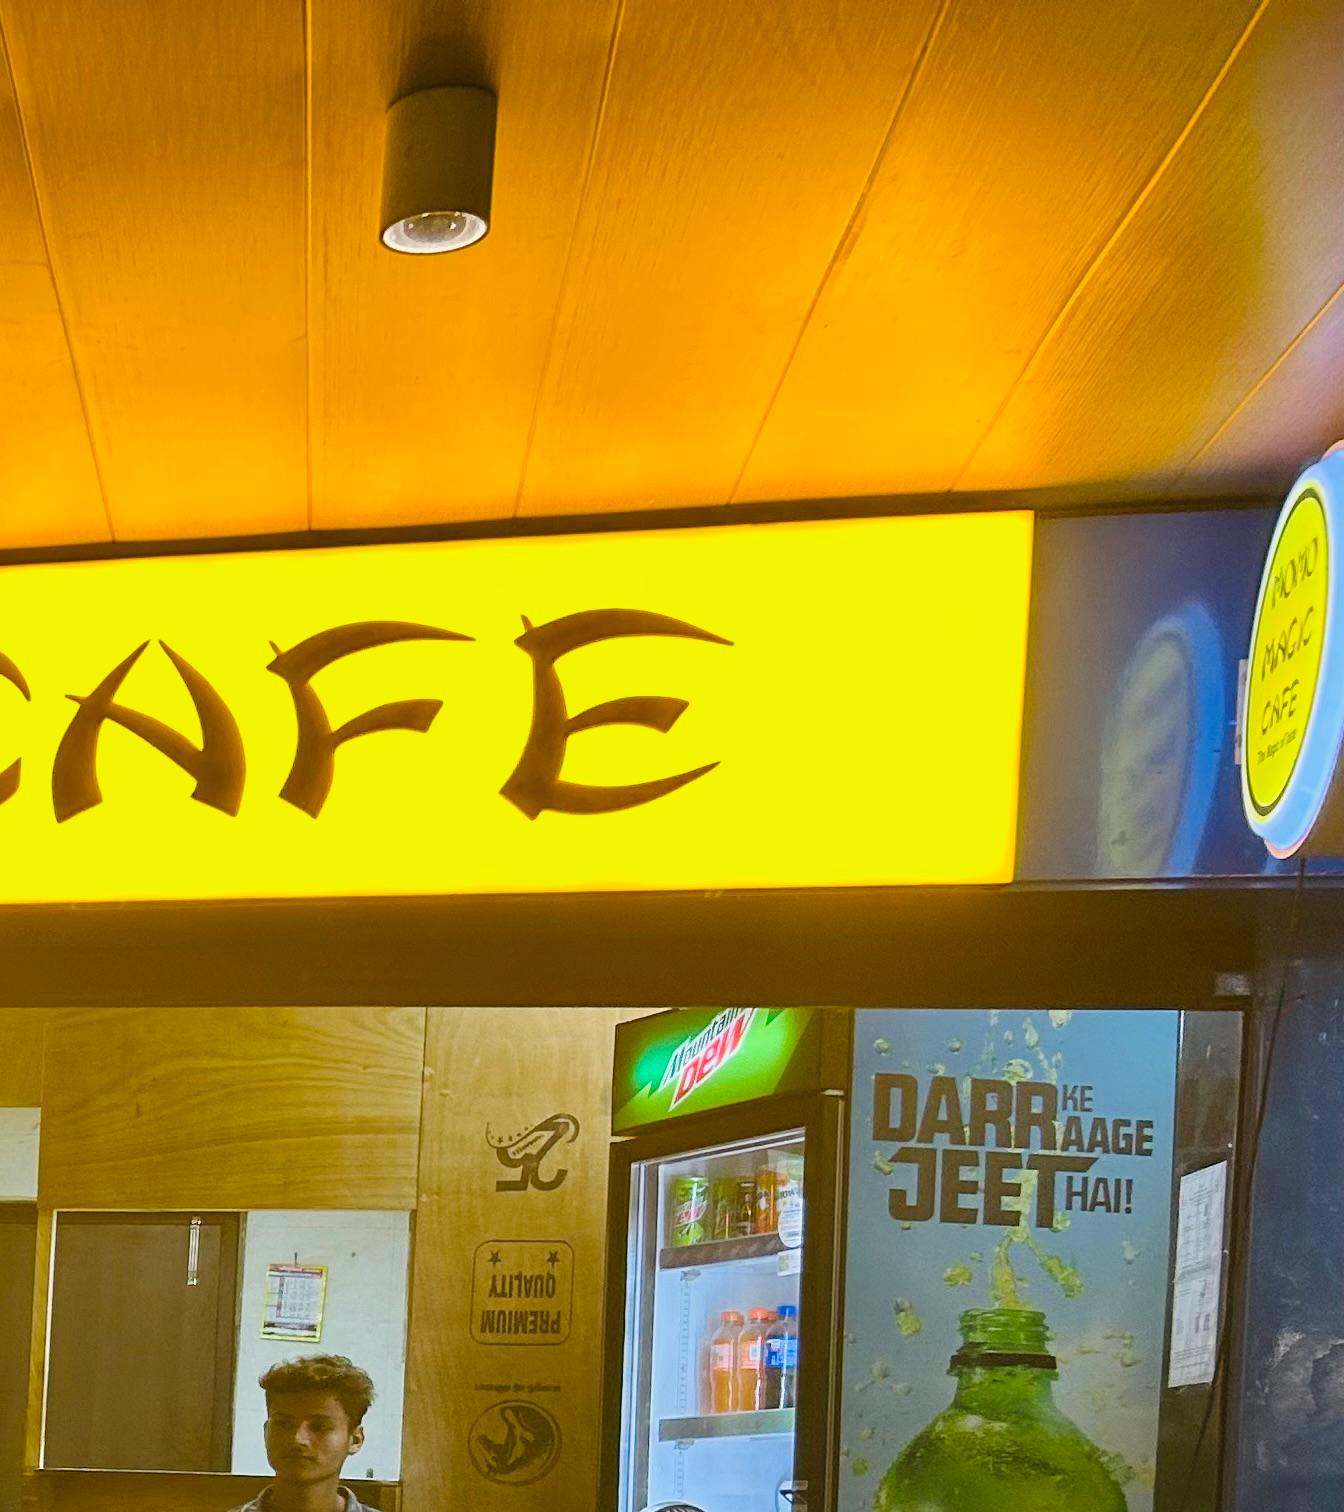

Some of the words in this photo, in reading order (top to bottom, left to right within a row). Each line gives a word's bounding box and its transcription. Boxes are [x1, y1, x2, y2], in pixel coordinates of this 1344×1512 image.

[1272, 537, 1318, 608] MOMO
[1262, 606, 1314, 680] MAGIC
[1262, 679, 1300, 735] CAFE
[872, 1072, 1058, 1151] DARR
[1062, 1084, 1094, 1112] KE
[1060, 1116, 1154, 1156] AAGE
[888, 1146, 1099, 1228] JEET
[1065, 1175, 1134, 1214] HAI!
[488, 1270, 556, 1298] QUALITY
[480, 1309, 561, 1335] PREMIUM
